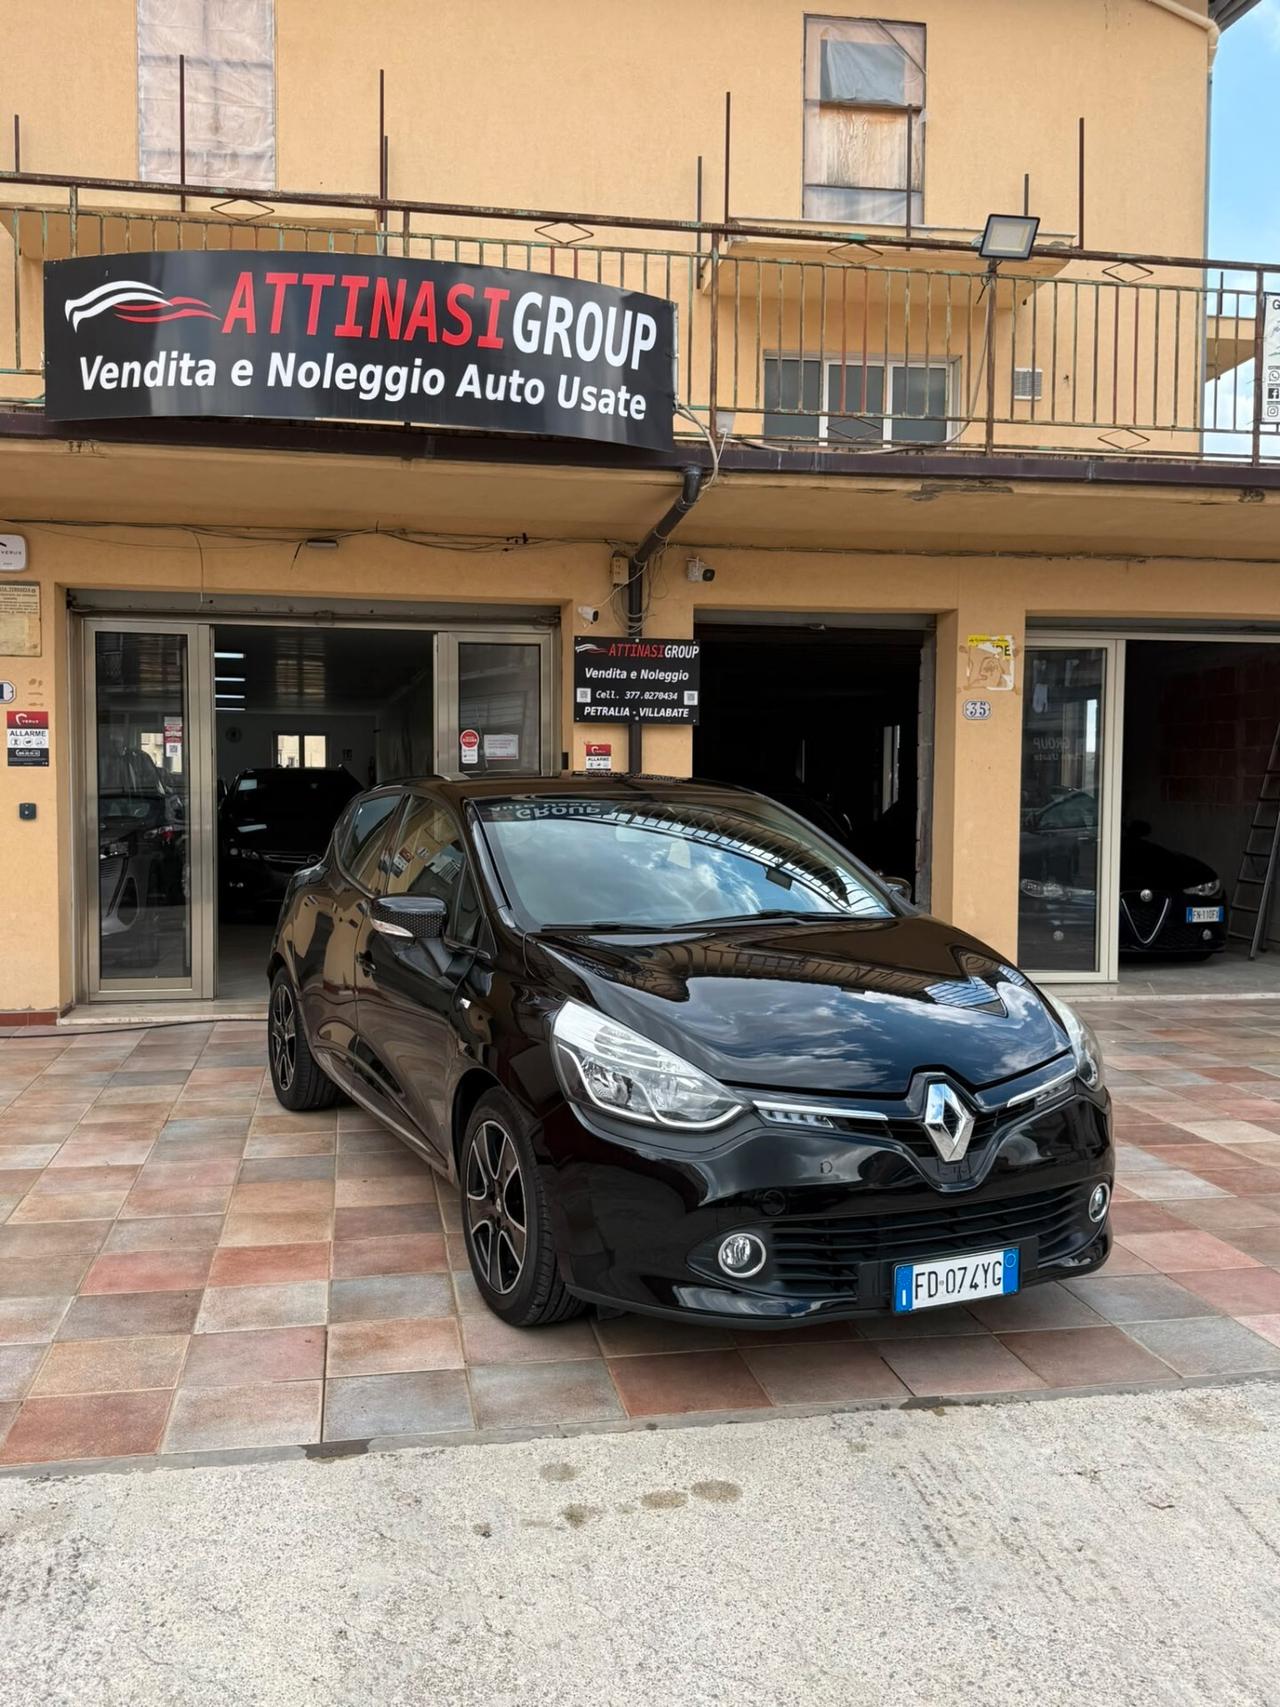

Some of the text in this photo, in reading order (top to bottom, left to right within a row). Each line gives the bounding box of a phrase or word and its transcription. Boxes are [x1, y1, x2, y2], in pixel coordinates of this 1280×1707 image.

[79, 350, 647, 420] Vendita e Noleggio Auto Usate
[585, 667, 689, 683] Vendita e Noleggio
[595, 690, 619, 699] Cell.
[584, 706, 630, 717] PETRALIA
[639, 707, 690, 718] VILLABATE
[969, 701, 987, 717] 35
